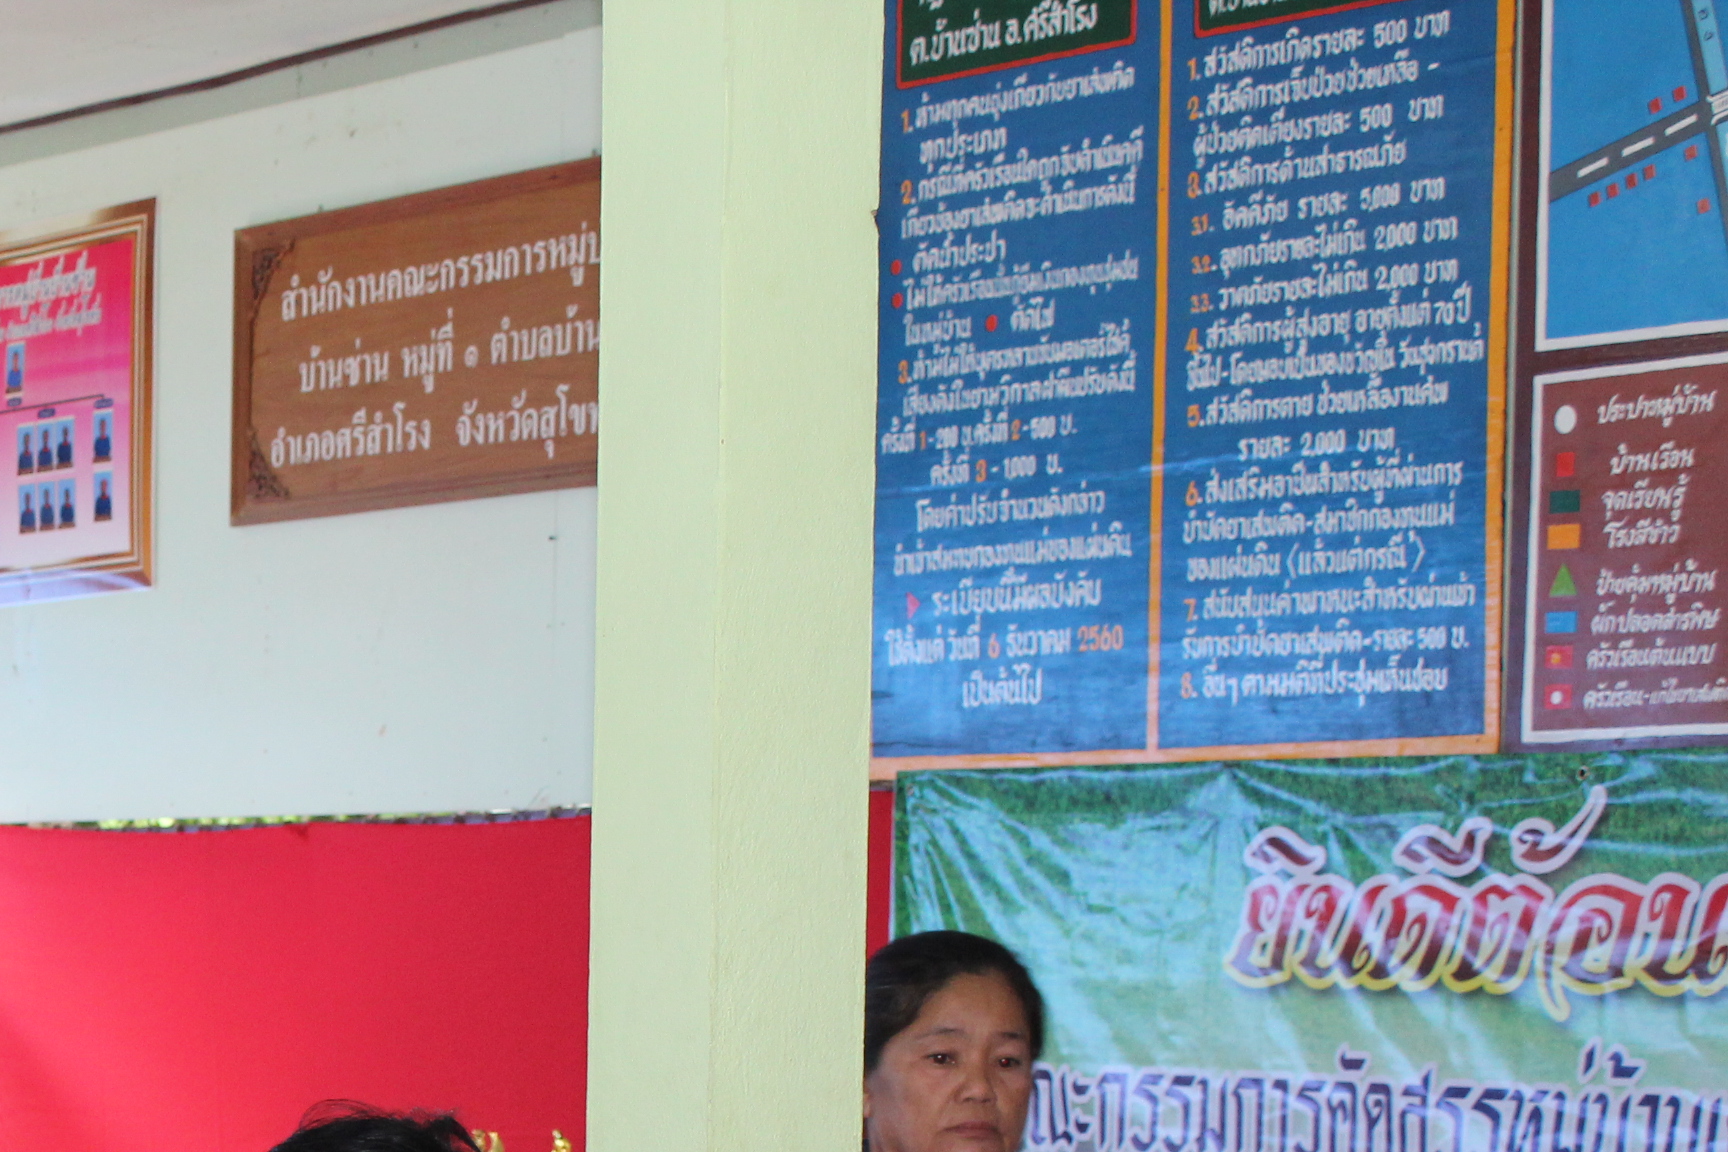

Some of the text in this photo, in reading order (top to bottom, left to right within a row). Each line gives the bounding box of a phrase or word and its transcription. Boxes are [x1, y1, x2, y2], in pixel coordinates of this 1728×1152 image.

[1373, 18, 1408, 49] 500
[1413, 9, 1451, 39] บาท
[1359, 103, 1394, 133] 500
[1408, 95, 1445, 122] บาท
[1297, 191, 1349, 220] รายละ
[1409, 176, 1446, 204] บาท
[1423, 216, 1460, 244] บาท
[1423, 258, 1460, 285] บาท
[299, 335, 390, 395] บ้านซ่าน
[401, 308, 455, 396] หมู่ที่
[1596, 382, 1719, 428] ประปาหมู่บ้าน
[270, 406, 432, 470] อำเภอศรีสำโรง
[1237, 434, 1292, 461] รายละ
[1356, 426, 1396, 454] บาท
[1609, 441, 1695, 476] บ้านเรือน
[1601, 473, 1691, 523] จุดเรียนรู้
[1603, 518, 1683, 549] โรงสีข้าว
[1590, 601, 1721, 635] ผักปลอดสารพิษ
[987, 632, 1001, 659] 6
[1077, 624, 1124, 653] 2560
[1584, 636, 1718, 671] ครัวเรือนต้นแบบ
